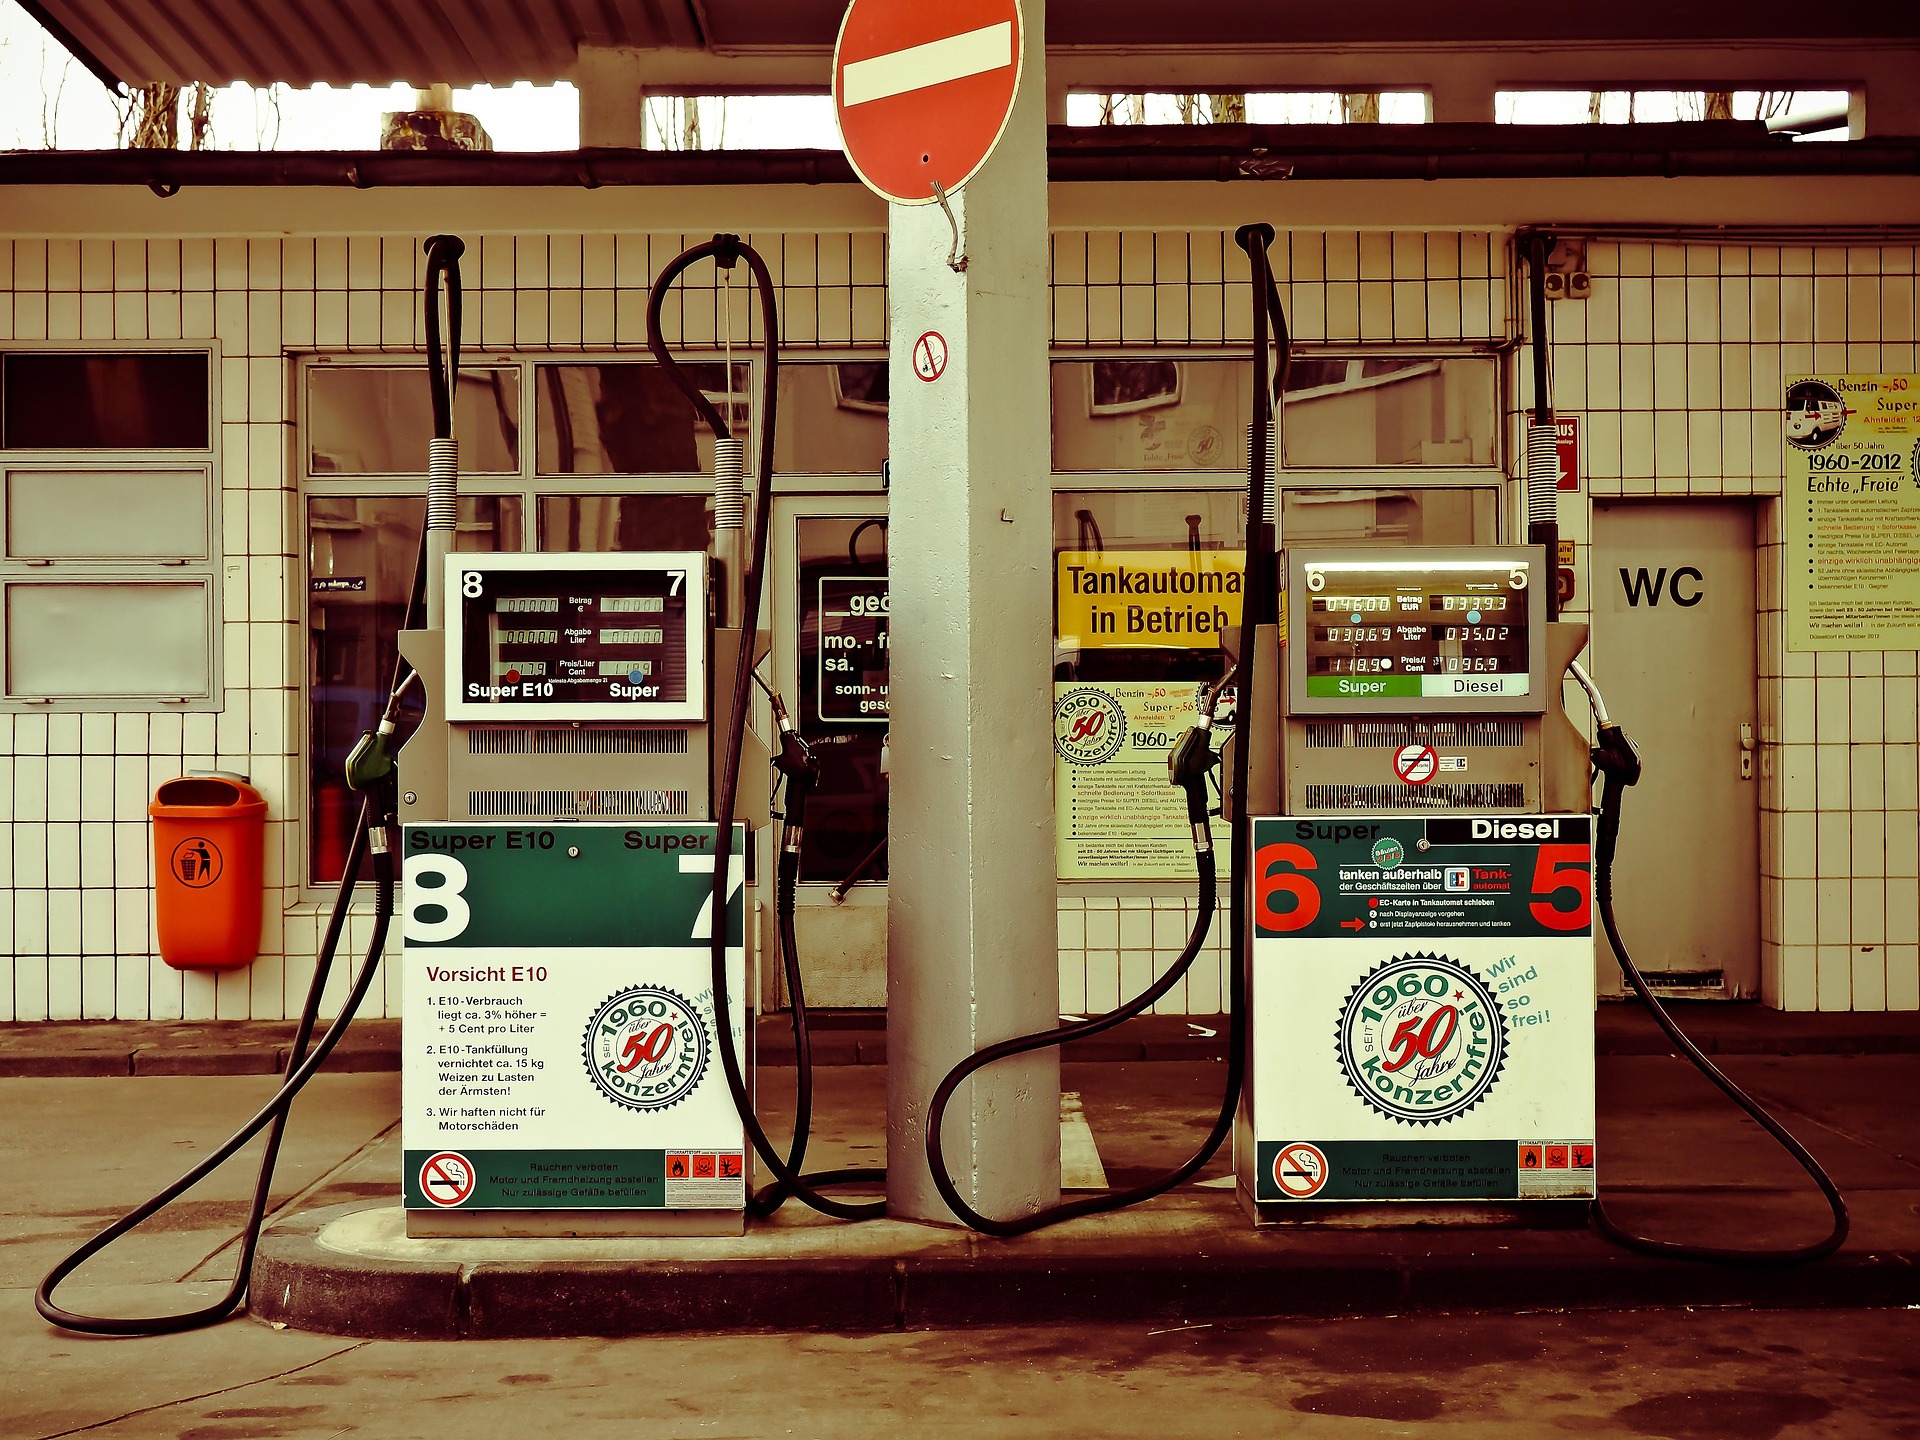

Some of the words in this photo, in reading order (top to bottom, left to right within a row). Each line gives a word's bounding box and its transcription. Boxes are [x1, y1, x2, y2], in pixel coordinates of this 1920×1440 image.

[1838, 379, 1878, 392] Benzin
[1878, 397, 1918, 412] Super
[1853, 442, 1863, 450] 50
[1808, 454, 1901, 470] 1960-2012
[1807, 476, 1849, 492] Echte
[462, 571, 483, 598] 8
[667, 571, 685, 597] 7
[1306, 568, 1326, 591] 6
[1508, 566, 1528, 589] 5
[1619, 566, 1705, 608] WC
[569, 597, 592, 605] Betrag
[1397, 596, 1422, 604] Betrag
[1401, 603, 1419, 611] EUR
[1091, 605, 1115, 633] in
[1127, 605, 1229, 633] Betrieb
[564, 628, 591, 637] Abgabe
[1403, 633, 1421, 641] Liter
[825, 635, 861, 648] mo.
[468, 683, 518, 699] Super
[523, 683, 554, 697] E10
[610, 683, 660, 699] Super
[835, 684, 876, 694] sonn-
[1115, 688, 1144, 697] Benzin
[1339, 679, 1386, 695] Super
[1454, 679, 1503, 692] Diesel
[1060, 696, 1099, 719] 1960
[1144, 702, 1172, 713] Super
[1060, 710, 1117, 757] konzernfrei
[1069, 711, 1104, 742] 50
[1295, 821, 1381, 844] Super
[1471, 819, 1559, 838] Diesel
[410, 831, 496, 853] Super
[506, 831, 555, 849] E10
[624, 831, 709, 853] Super
[1339, 869, 1380, 880] tanken
[1382, 868, 1442, 880] außerhalb
[1449, 871, 1465, 887] EC
[1472, 869, 1512, 880] Tank-
[1256, 843, 1321, 931] 6
[1339, 882, 1352, 890] der
[1355, 882, 1421, 891] Geschäftszeiten
[1423, 882, 1442, 891] über
[1473, 882, 1511, 890] automat
[1529, 844, 1592, 930] 5
[404, 853, 470, 942] 8
[678, 854, 744, 939] 7
[1379, 899, 1411, 907] EC-Karte
[1420, 899, 1463, 907] Tankautomat
[1464, 899, 1495, 907] schieben
[1395, 910, 1437, 918] Displayanzeige
[427, 966, 505, 982] Vorsicht
[512, 966, 547, 982] E10
[1485, 954, 1516, 978] Wir
[1498, 965, 1538, 993] sind
[427, 997, 436, 1006] 1.
[438, 996, 523, 1006] E10-Verbrauch
[1361, 973, 1449, 1024] 1960
[1507, 994, 1531, 1010] so
[438, 1010, 462, 1022] liegt
[465, 1012, 481, 1020] ca.
[484, 1010, 502, 1020] 3%
[505, 1009, 537, 1020] höher
[1398, 998, 1429, 1018] über
[601, 1000, 667, 1037] 1960
[628, 1018, 652, 1033] über
[1511, 1009, 1551, 1028] frei!
[448, 1024, 455, 1034] 5
[459, 1024, 485, 1034] Cent
[488, 1026, 507, 1036] pro
[510, 1024, 535, 1034] Liter
[1364, 1025, 1374, 1053] SEIT
[1382, 1005, 1459, 1072] 50
[426, 1045, 436, 1055] 2.
[439, 1044, 528, 1057] E10-Tankfüllung
[616, 1023, 673, 1073] 50
[1361, 1001, 1488, 1104] konzernfrei
[438, 1059, 493, 1069] vernichtet
[496, 1061, 512, 1069] ca.
[516, 1059, 528, 1068] 15
[531, 1058, 544, 1071] kg
[601, 1020, 696, 1097] konzernfrei
[438, 1073, 478, 1082] Weizen
[497, 1073, 535, 1082] Lasten
[636, 1060, 673, 1084] Jahre
[1408, 1052, 1457, 1087] Jahre
[438, 1087, 457, 1096] der
[460, 1084, 511, 1096] Ärmsten!
[426, 1108, 436, 1117] 3.
[439, 1107, 457, 1116] Wir
[460, 1107, 496, 1117] haften
[499, 1107, 527, 1117] nicht
[530, 1107, 546, 1117] für
[438, 1120, 519, 1131] Motorschäden
[1383, 1153, 1425, 1162] Rauchen
[1428, 1153, 1470, 1162] verboten
[530, 1162, 572, 1171] Rauchen
[575, 1162, 618, 1171] verboten
[1343, 1166, 1371, 1175] Motor
[1373, 1166, 1392, 1175] und
[1395, 1166, 1464, 1177] Fremdheizung
[1467, 1166, 1511, 1175] abstellen
[489, 1175, 518, 1184] Motor
[521, 1175, 540, 1184] und
[542, 1175, 612, 1186] Fremdheizung
[615, 1175, 659, 1184] abstellen
[1355, 1179, 1372, 1188] Nur
[1460, 1178, 1499, 1188] befüllen
[502, 1188, 520, 1197] Nur
[522, 1187, 567, 1199] zulässige
[608, 1187, 646, 1197] befüllen
